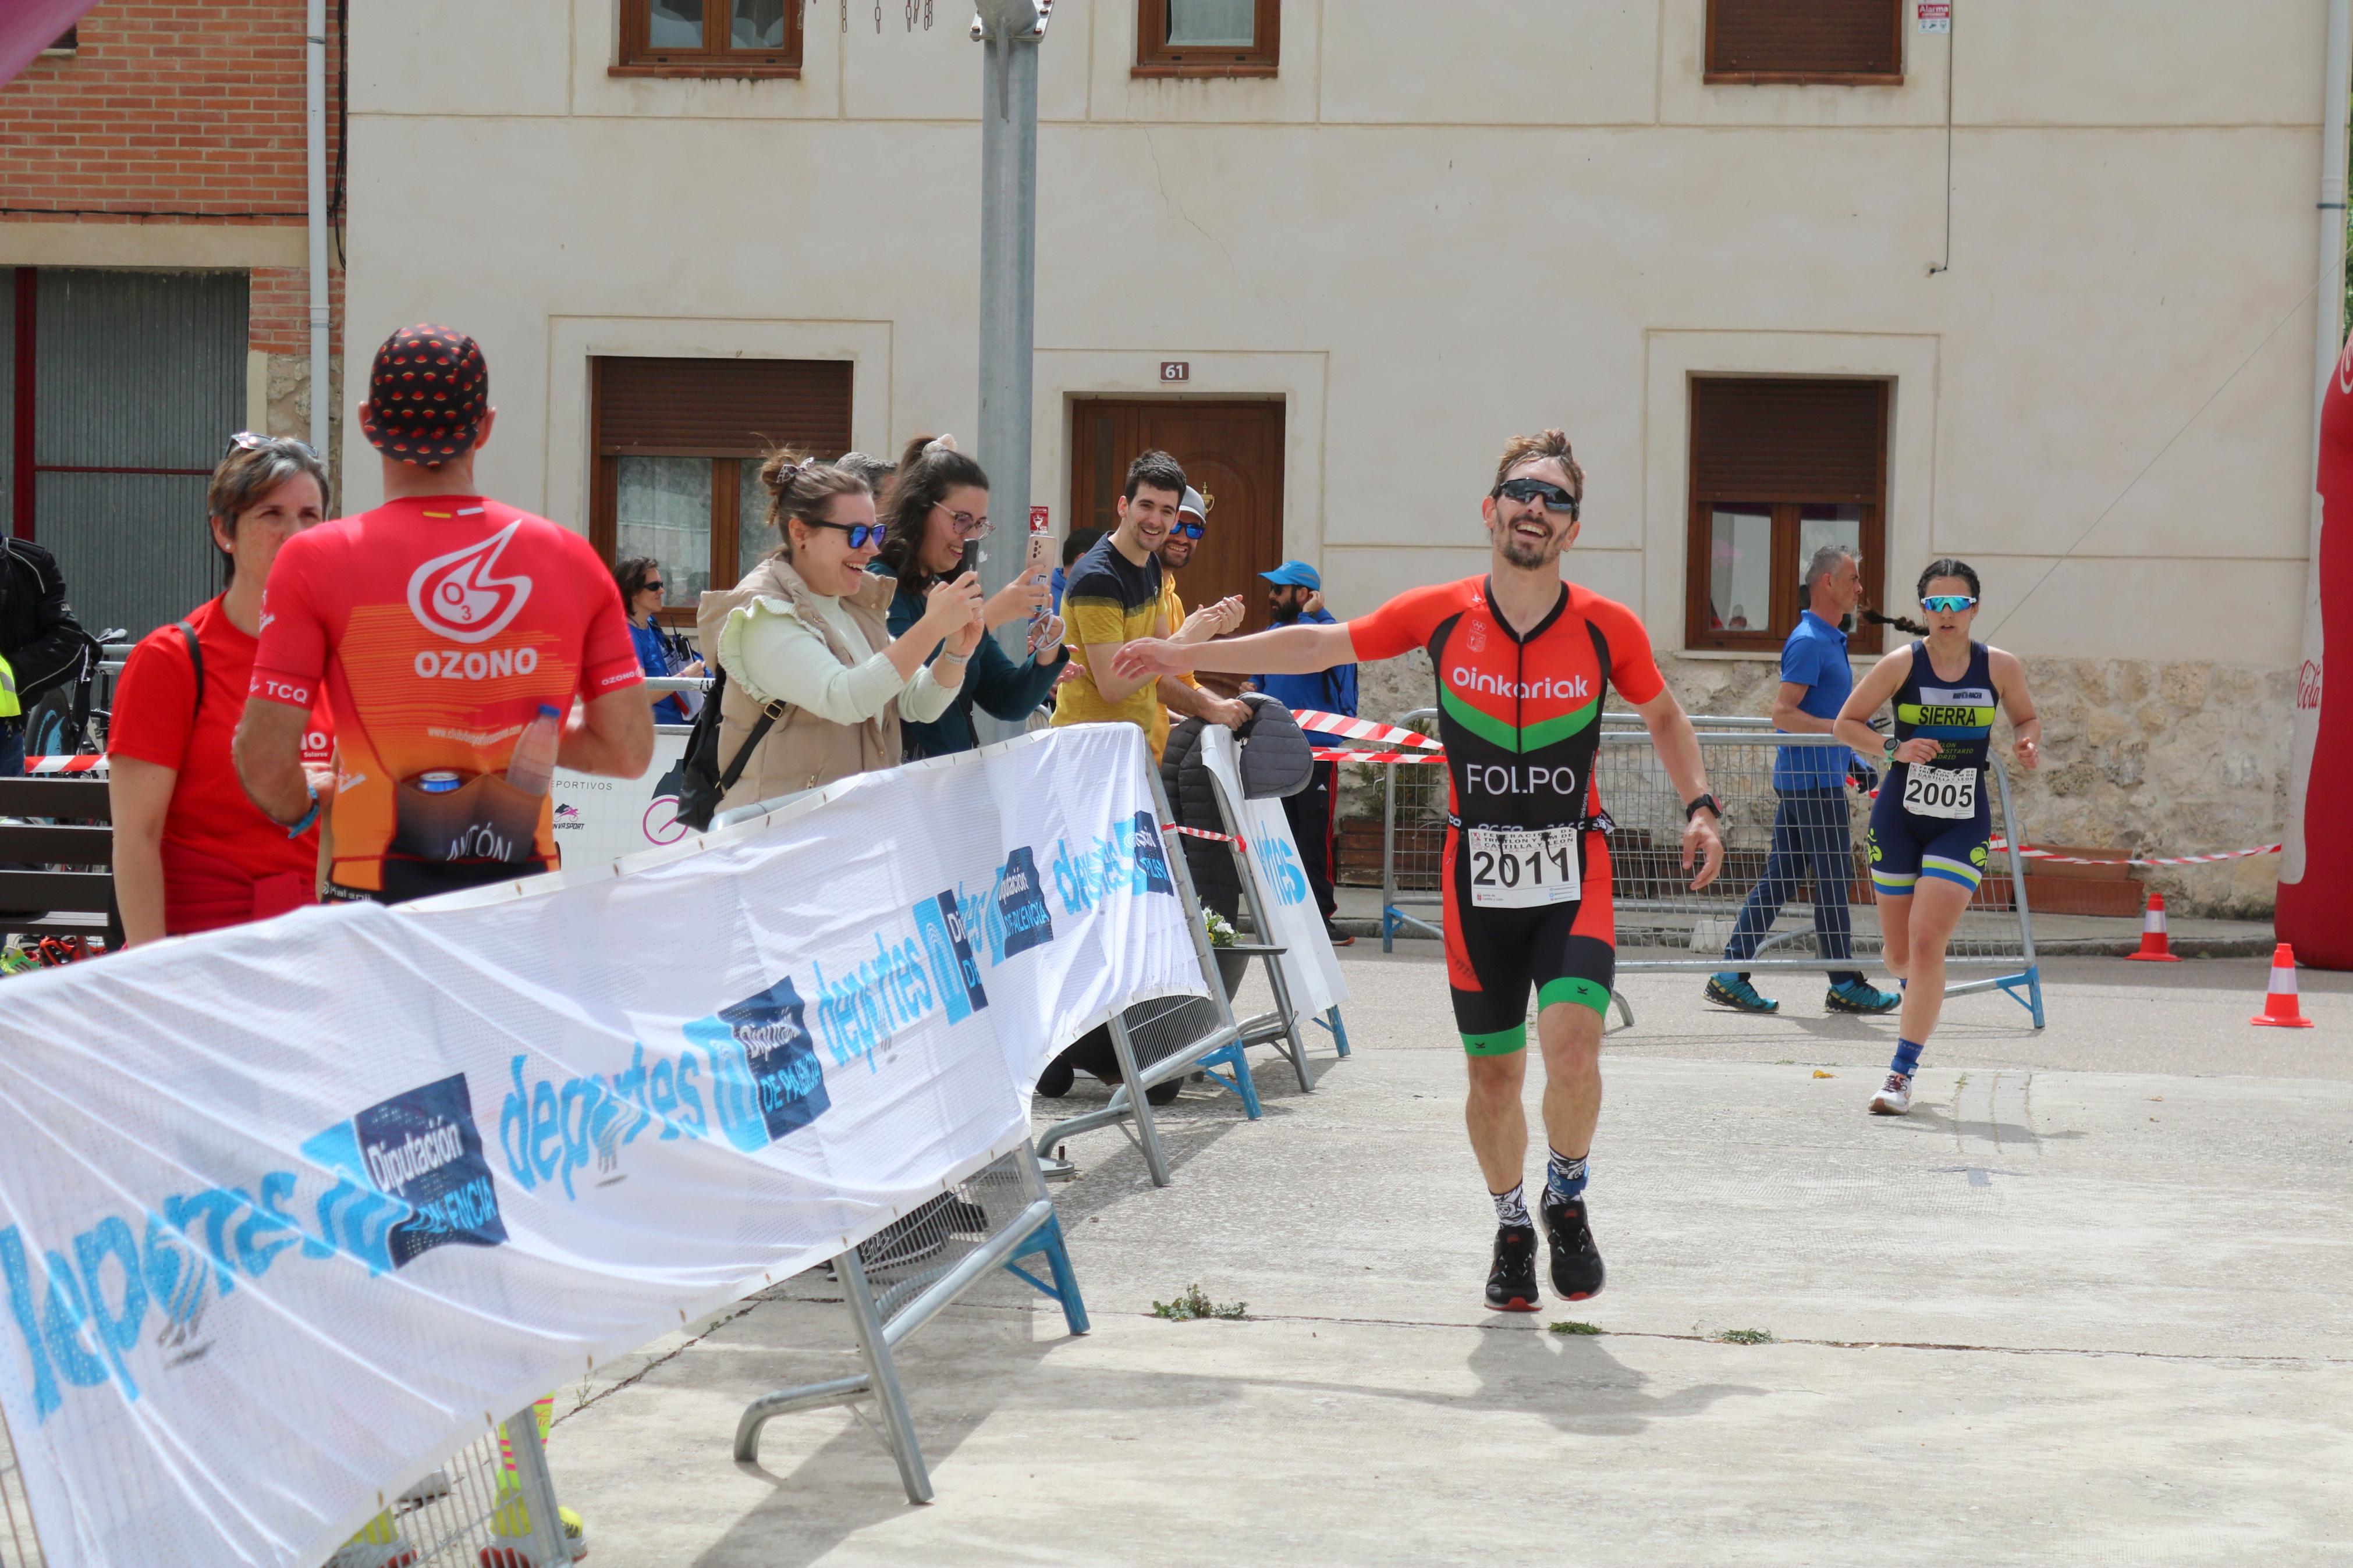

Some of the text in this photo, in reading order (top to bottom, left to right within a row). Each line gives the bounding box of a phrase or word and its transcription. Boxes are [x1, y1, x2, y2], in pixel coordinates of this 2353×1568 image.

[1165, 364, 1183, 378] 61
[414, 648, 537, 680] OZONO
[601, 671, 634, 685] OZONO
[266, 681, 307, 704] TCQ
[1453, 667, 1588, 698] oinkariak
[1918, 706, 1976, 726] SIERRA
[552, 780, 613, 791] EPORTIVOS
[1905, 779, 1972, 808] 2005
[1473, 847, 1570, 888] 2011
[1010, 901, 1050, 935] PALENCIA
[760, 1074, 783, 1114] DE
[499, 1041, 709, 1202] deportes
[367, 1115, 465, 1197] Diputación
